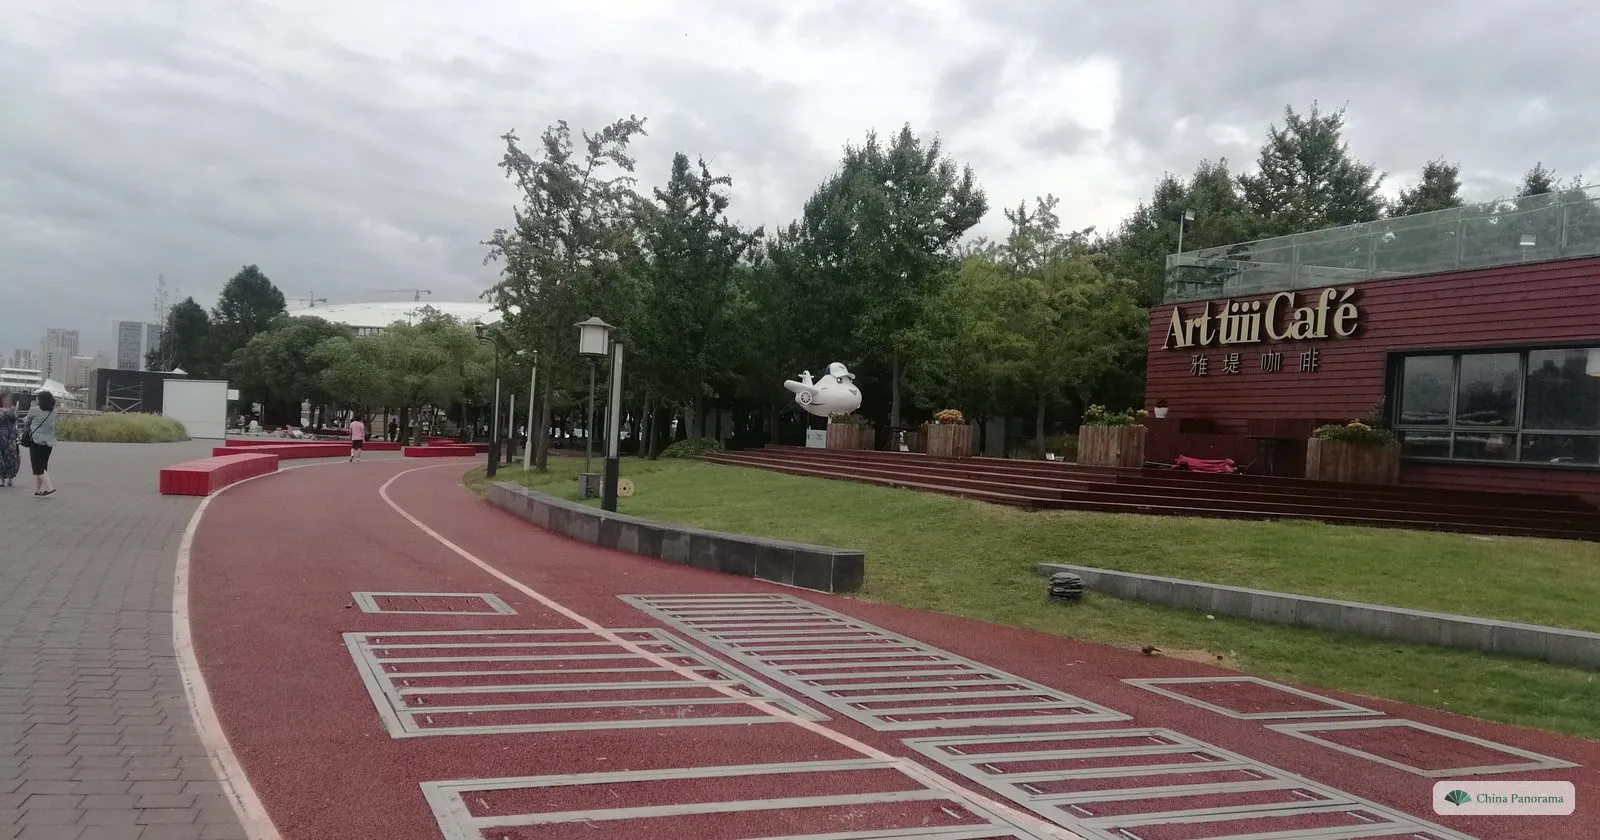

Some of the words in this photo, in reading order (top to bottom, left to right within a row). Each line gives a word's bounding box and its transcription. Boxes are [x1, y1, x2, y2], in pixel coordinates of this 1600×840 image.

[1161, 301, 1215, 349] Art
[1265, 287, 1358, 340] Café
[1190, 348, 1318, 376] 雅堤咖啡
